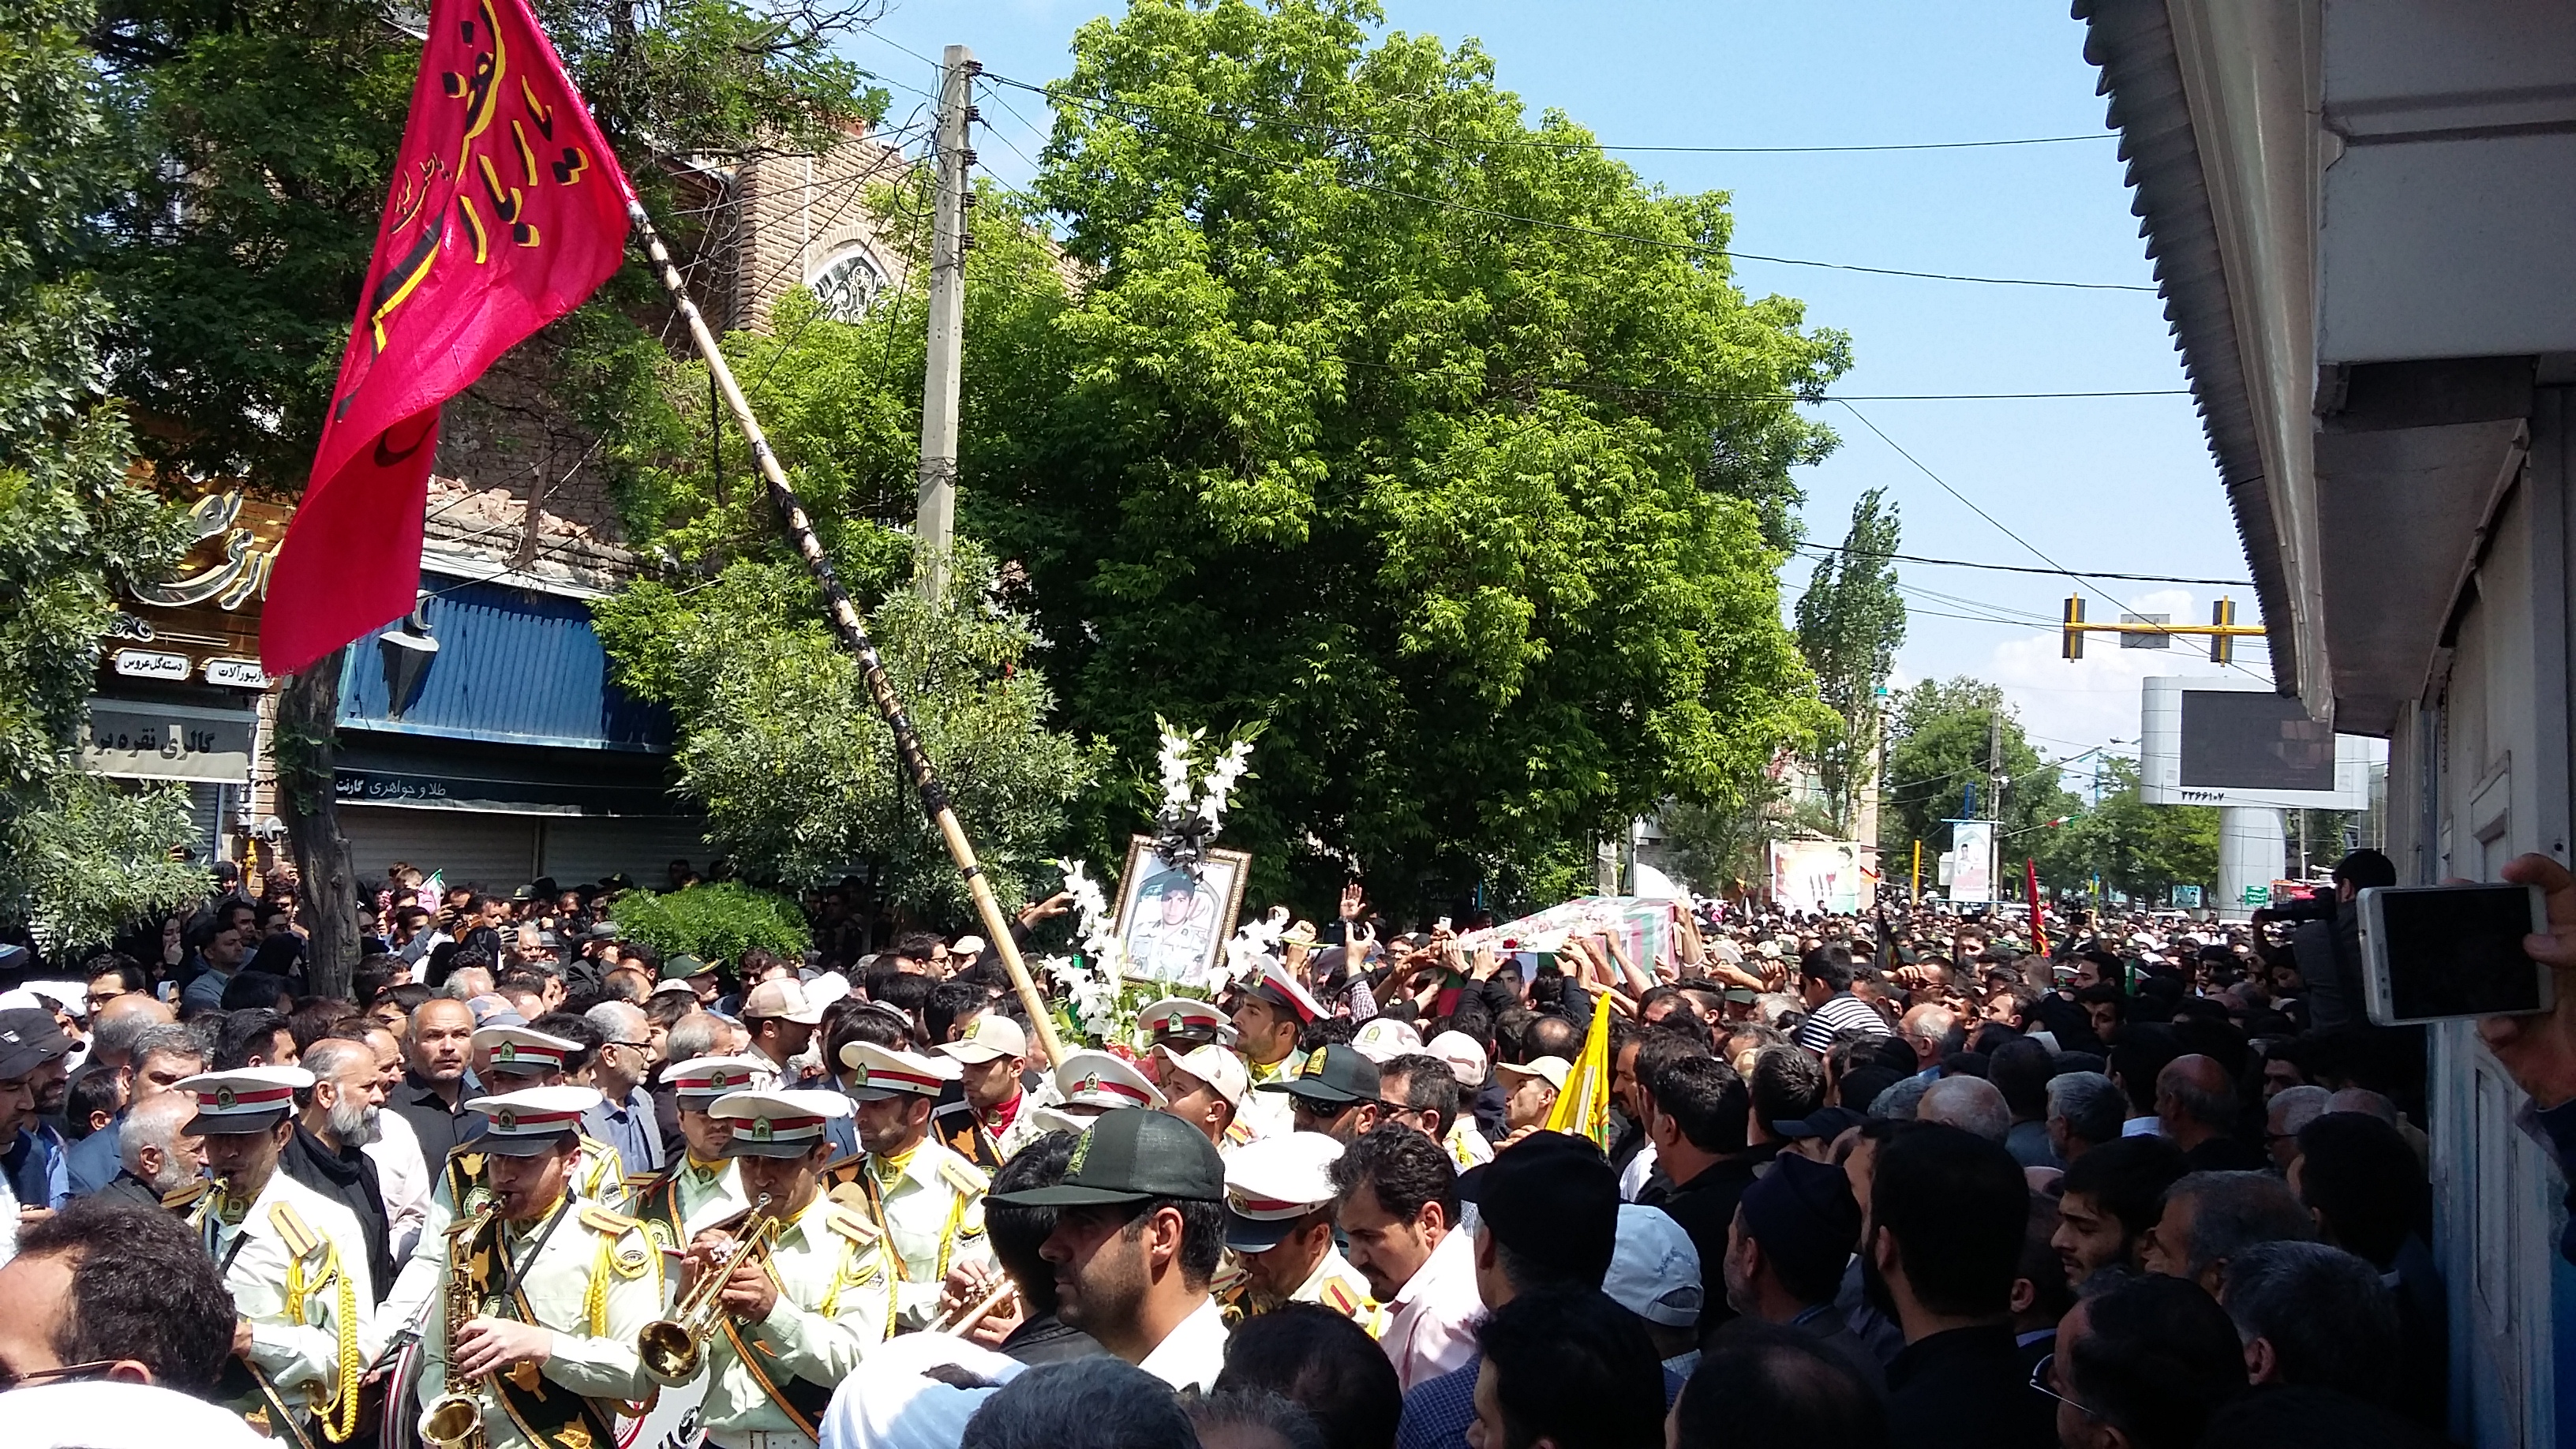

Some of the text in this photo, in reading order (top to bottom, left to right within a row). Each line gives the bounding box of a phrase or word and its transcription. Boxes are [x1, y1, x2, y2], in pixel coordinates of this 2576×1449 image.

[118, 728, 155, 758] نقره
[160, 730, 215, 761] گالری
[335, 778, 447, 799] طلا و جواهری گارنت
